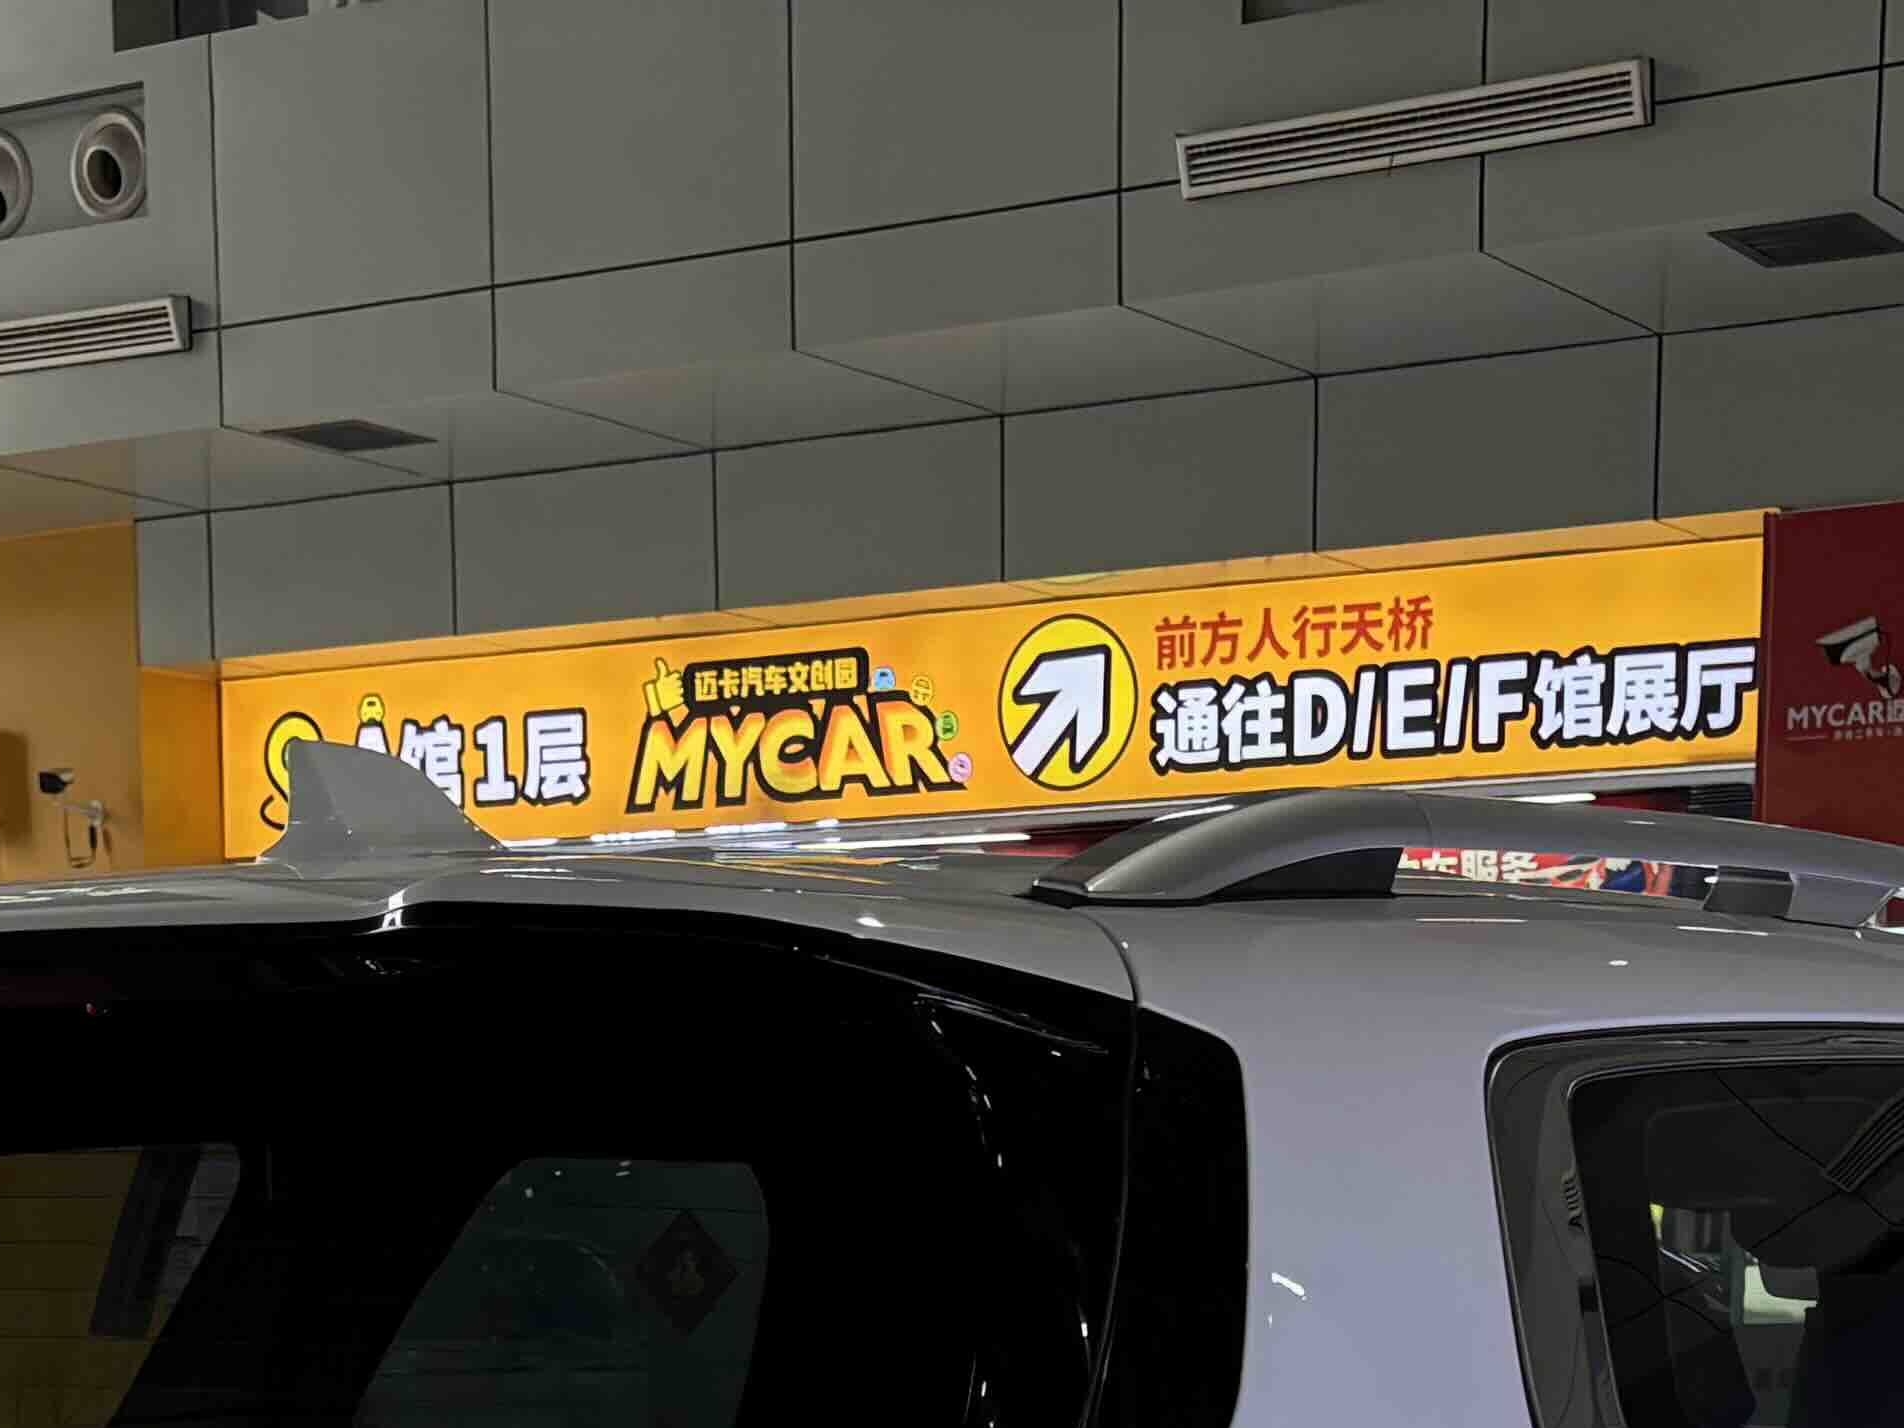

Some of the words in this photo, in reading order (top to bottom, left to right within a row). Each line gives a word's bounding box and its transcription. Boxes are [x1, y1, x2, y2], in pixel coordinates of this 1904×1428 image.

[1155, 595, 1434, 670] 前方人行天桥
[693, 656, 860, 703] 迈卡汽车文创园
[1152, 643, 1757, 770] 通往D/E/F馆展厅
[630, 700, 956, 811] MYCAR
